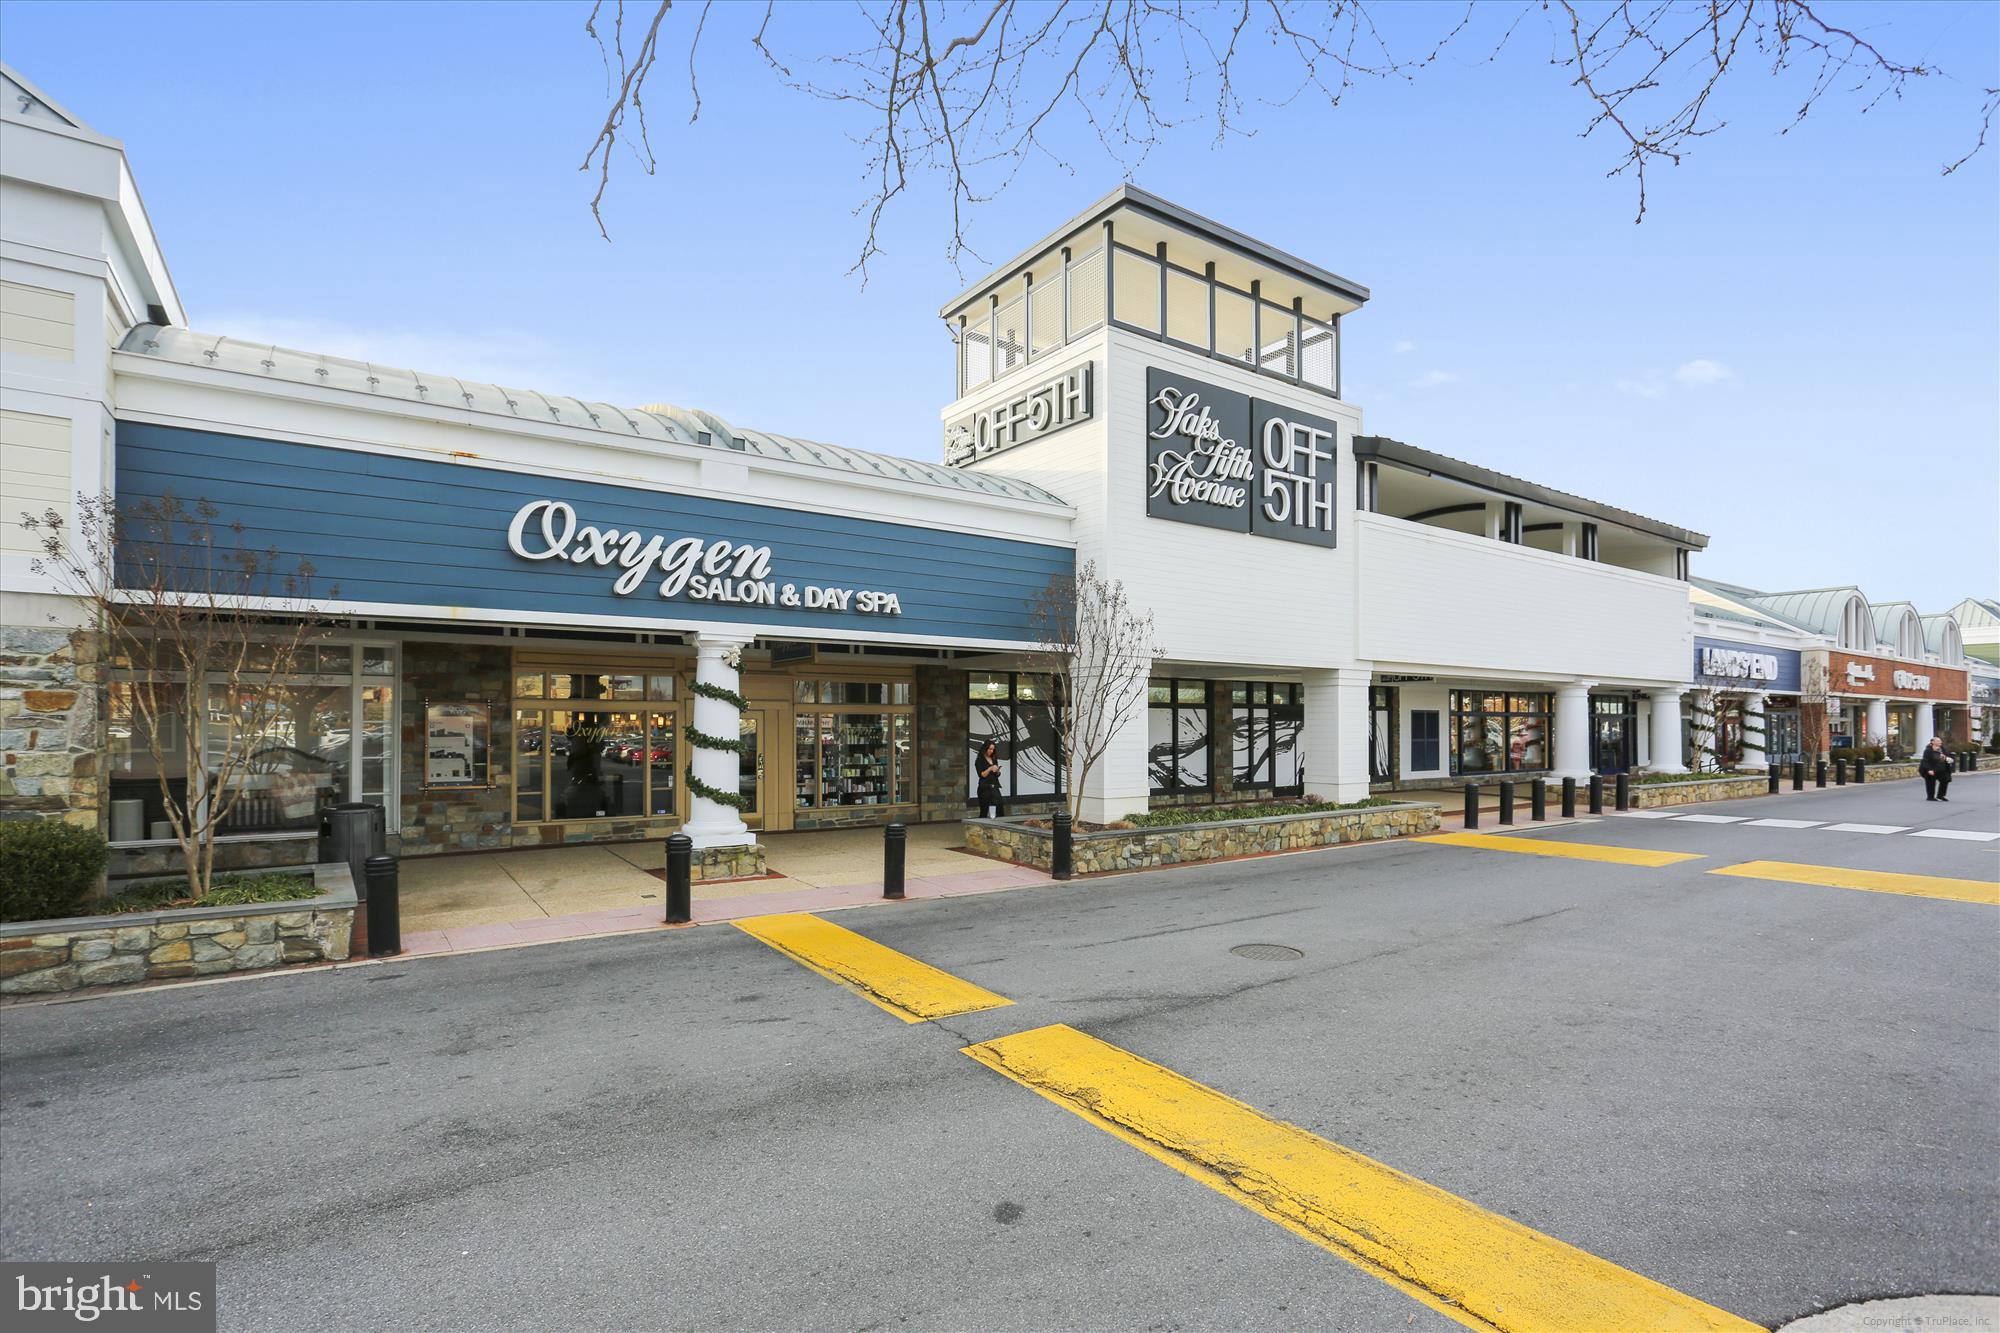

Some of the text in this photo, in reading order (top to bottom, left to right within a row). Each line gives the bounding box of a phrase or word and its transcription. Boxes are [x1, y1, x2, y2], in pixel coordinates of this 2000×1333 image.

[975, 395, 1027, 453] OFF
[1027, 368, 1089, 431] 5TH
[1149, 387, 1220, 442] Saks
[1187, 432, 1255, 482] Fifth
[1264, 417, 1333, 477] OFF
[1149, 449, 1246, 508] Avenue
[1264, 468, 1333, 531] 5TH
[507, 500, 772, 598] Oxygen
[688, 575, 902, 615] SALON & DAY SPA
